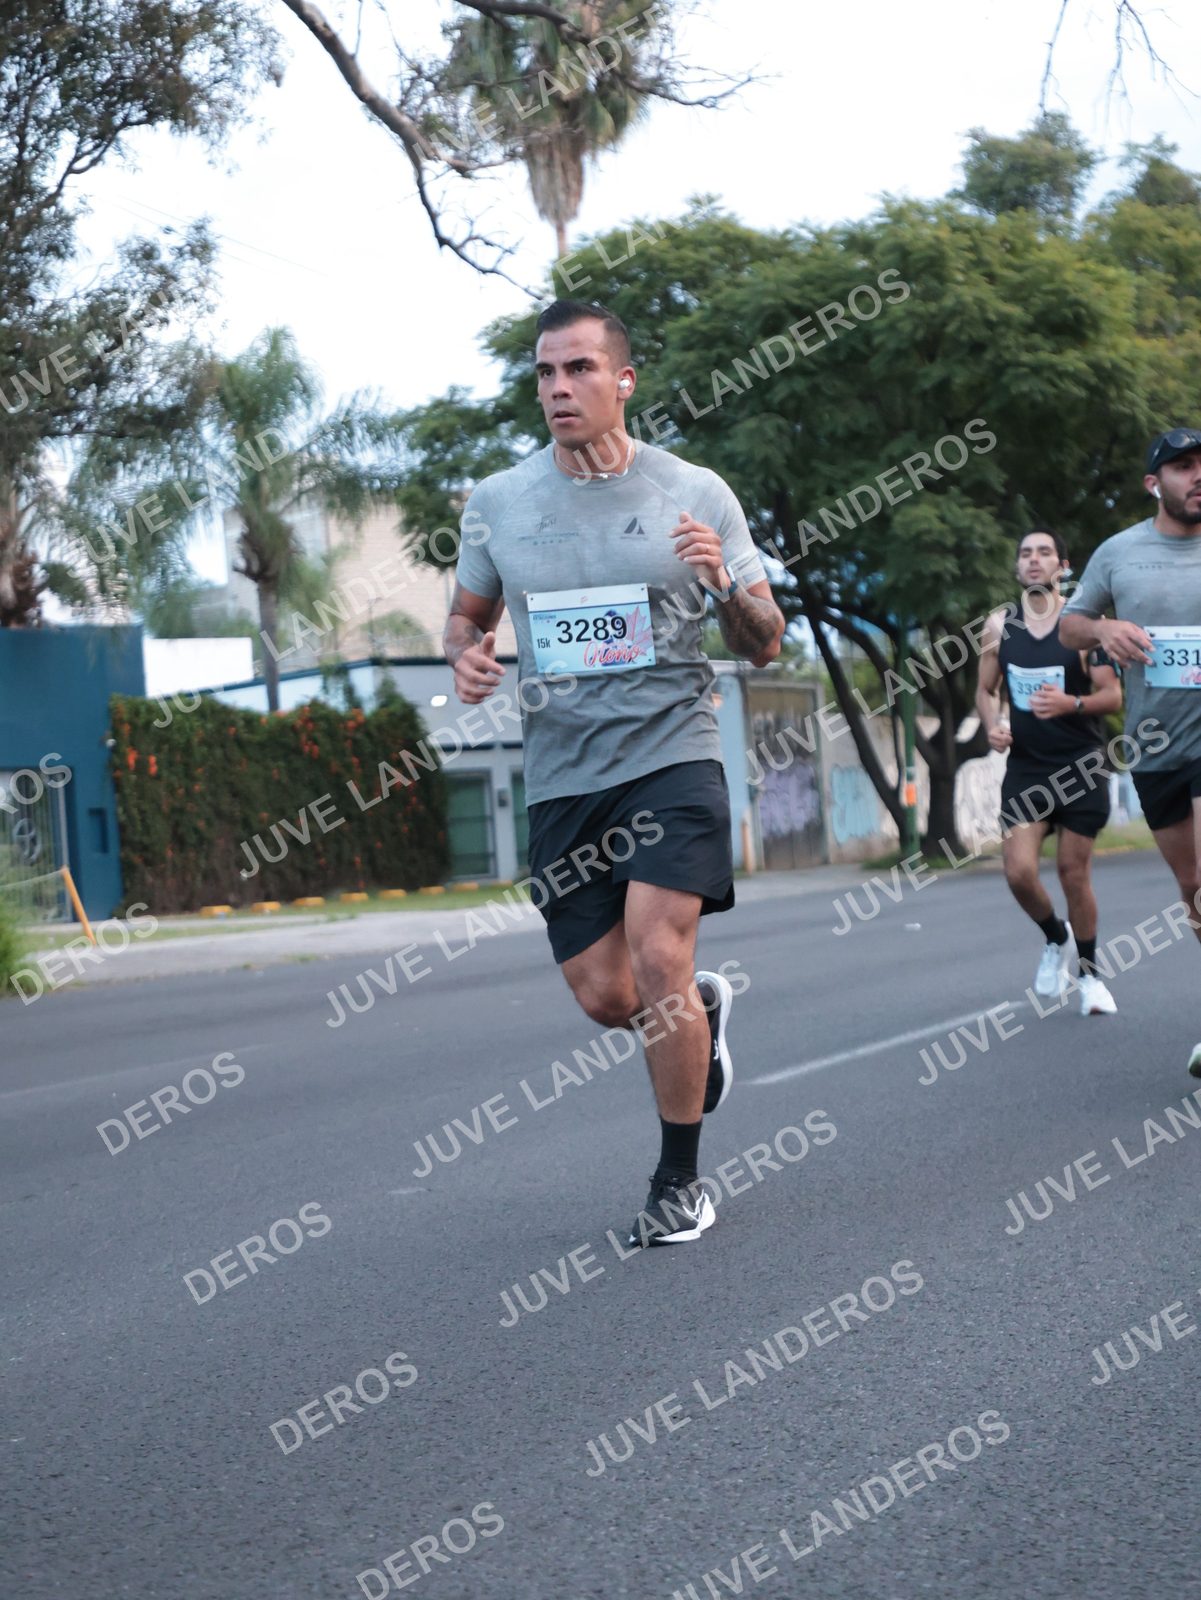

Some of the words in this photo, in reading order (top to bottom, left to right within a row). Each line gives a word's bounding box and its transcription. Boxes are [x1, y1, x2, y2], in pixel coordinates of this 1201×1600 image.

[556, 616, 628, 644] 3289
[537, 638, 551, 649] 15k
[1163, 648, 1201, 666] 331
